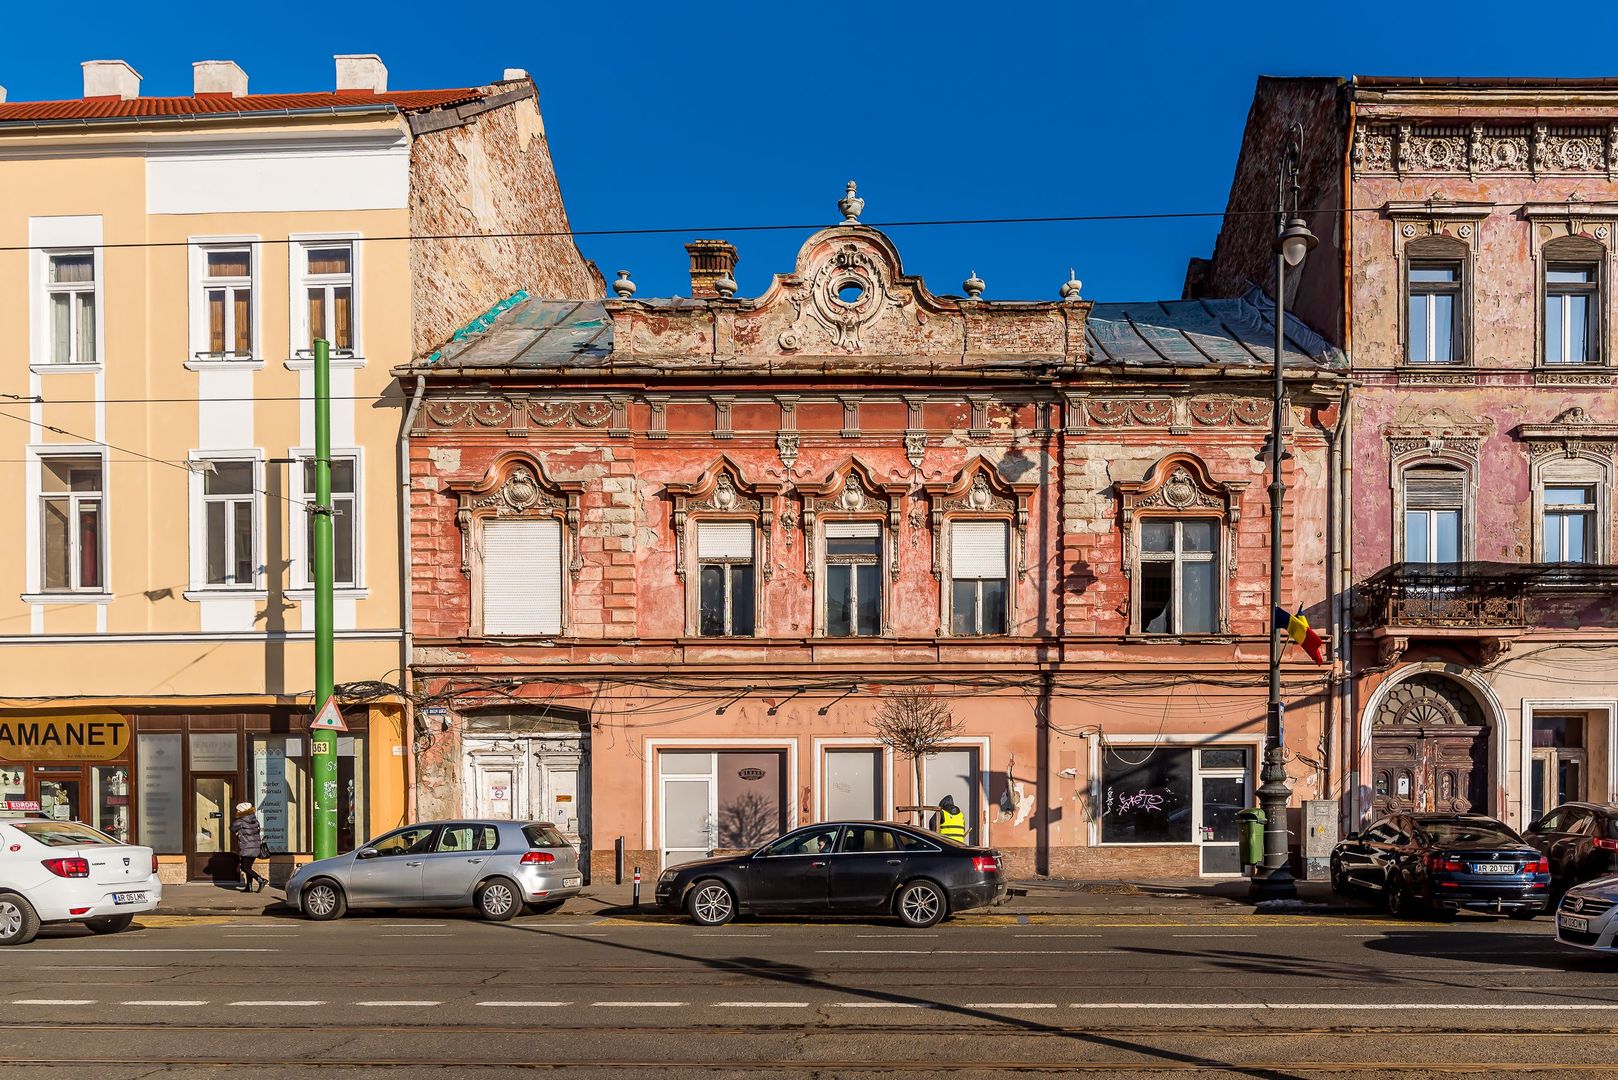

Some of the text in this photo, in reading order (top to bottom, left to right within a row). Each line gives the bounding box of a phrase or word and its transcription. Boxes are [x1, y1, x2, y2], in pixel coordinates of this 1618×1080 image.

[0, 723, 124, 745] AMANET
[1478, 864, 1487, 872] AR
[1489, 864, 1498, 872] 20
